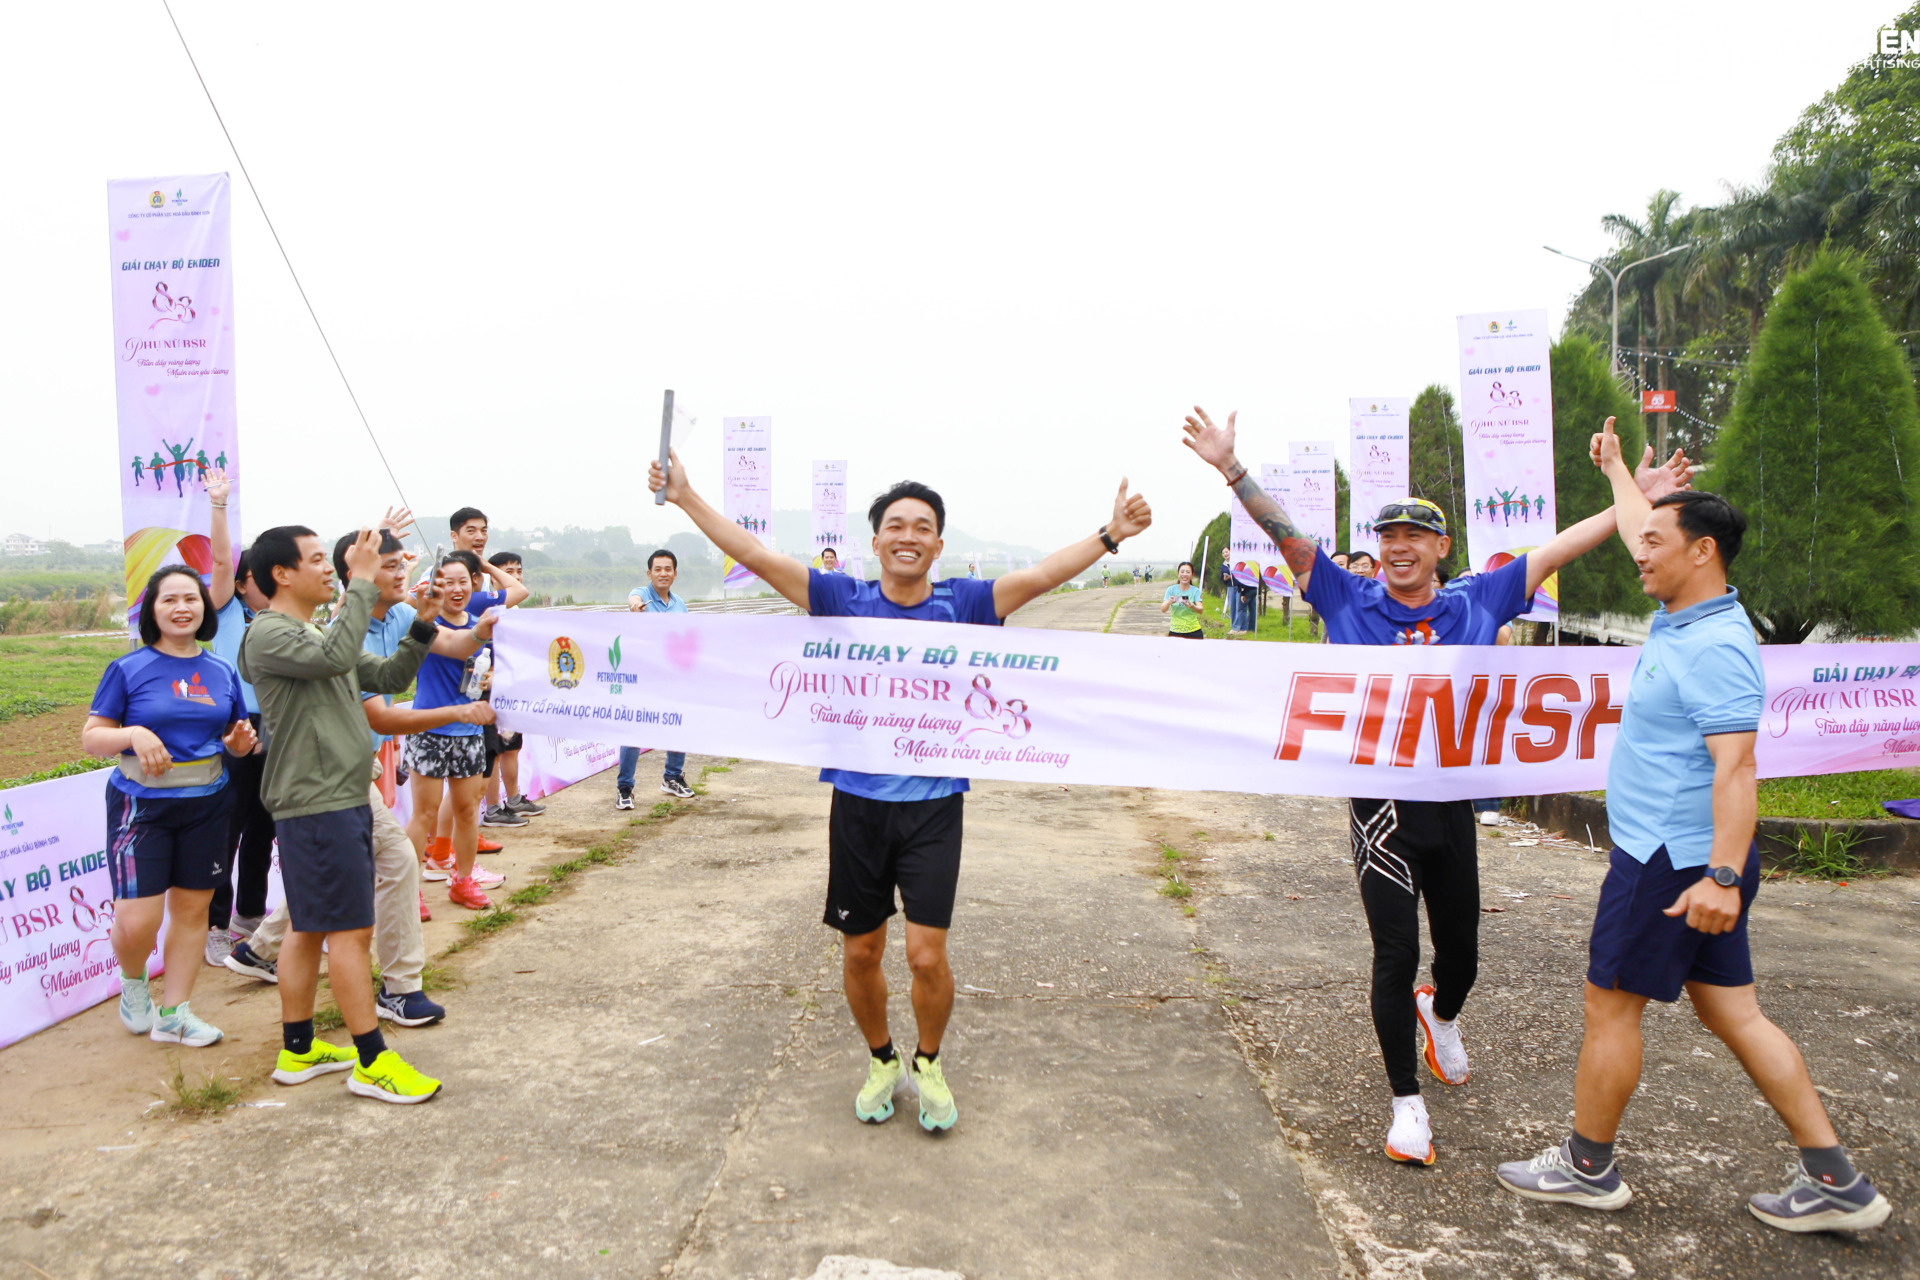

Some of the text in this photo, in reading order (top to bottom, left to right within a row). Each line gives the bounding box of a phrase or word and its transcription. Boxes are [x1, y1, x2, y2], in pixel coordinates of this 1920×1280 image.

[144, 260, 168, 272] CHẠY
[172, 257, 184, 271] BỘ
[187, 258, 220, 269] EKIDEN
[183, 339, 206, 348] BSR
[803, 638, 1060, 672] GIẢI CHẠY BỘ EKIDEN
[596, 672, 638, 684] PETROVIETNAM
[841, 672, 882, 698] NỮ
[889, 676, 951, 702] BSR
[1812, 662, 1848, 682] GIẢI
[1853, 666, 1900, 682] CHẠY
[610, 684, 623, 694] BSR
[1839, 688, 1870, 710] NỮ
[1873, 688, 1918, 708] BSR
[494, 695, 683, 726] CÔNG TY CỔ PHẦN LỌC HOÁ DẦU BÌNH SƠN
[810, 702, 842, 724] Tràn
[872, 712, 916, 734] năng
[917, 712, 962, 735] lượng
[1273, 671, 1625, 769] FINISH
[1814, 718, 1847, 736] Tràn
[1873, 718, 1901, 736] năng
[894, 736, 1070, 768] Muôn vàn yêu thương
[25, 864, 52, 892] BỘ
[58, 849, 108, 882] EKIDE
[11, 903, 64, 939] BSR
[14, 953, 48, 974] năng
[50, 938, 81, 961] lượng
[40, 970, 83, 999] Muôn
[84, 960, 105, 980] vàn
